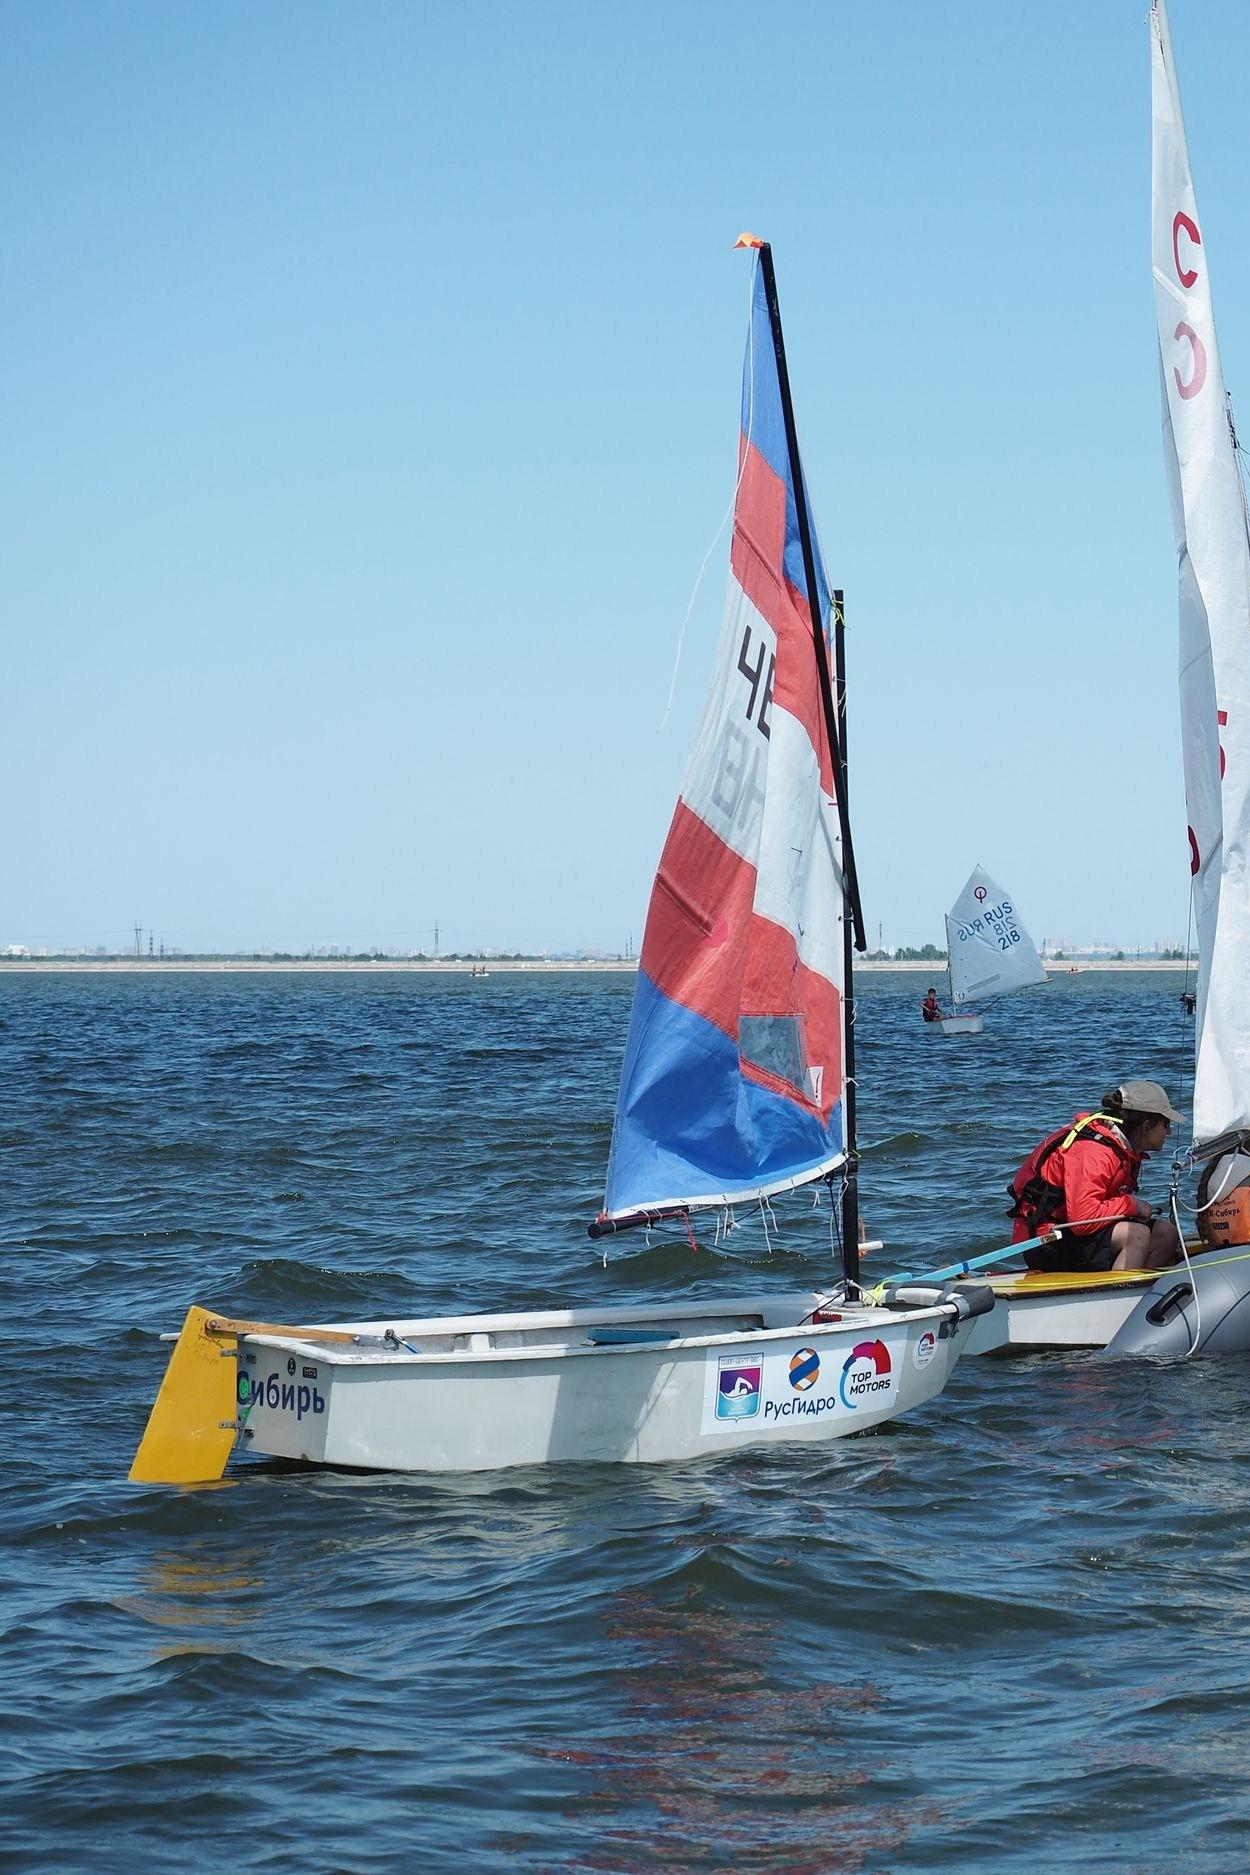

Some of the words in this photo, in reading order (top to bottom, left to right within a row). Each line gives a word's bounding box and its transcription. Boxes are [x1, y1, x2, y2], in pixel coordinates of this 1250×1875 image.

[1172, 211, 1201, 289] C
[983, 901, 1013, 926] RUS
[997, 930, 1021, 951] 218
[850, 1379, 891, 1395] MOTORS
[851, 1372, 872, 1383] TOP
[237, 1371, 325, 1421] Сибирь
[764, 1397, 836, 1420] РусГидро
